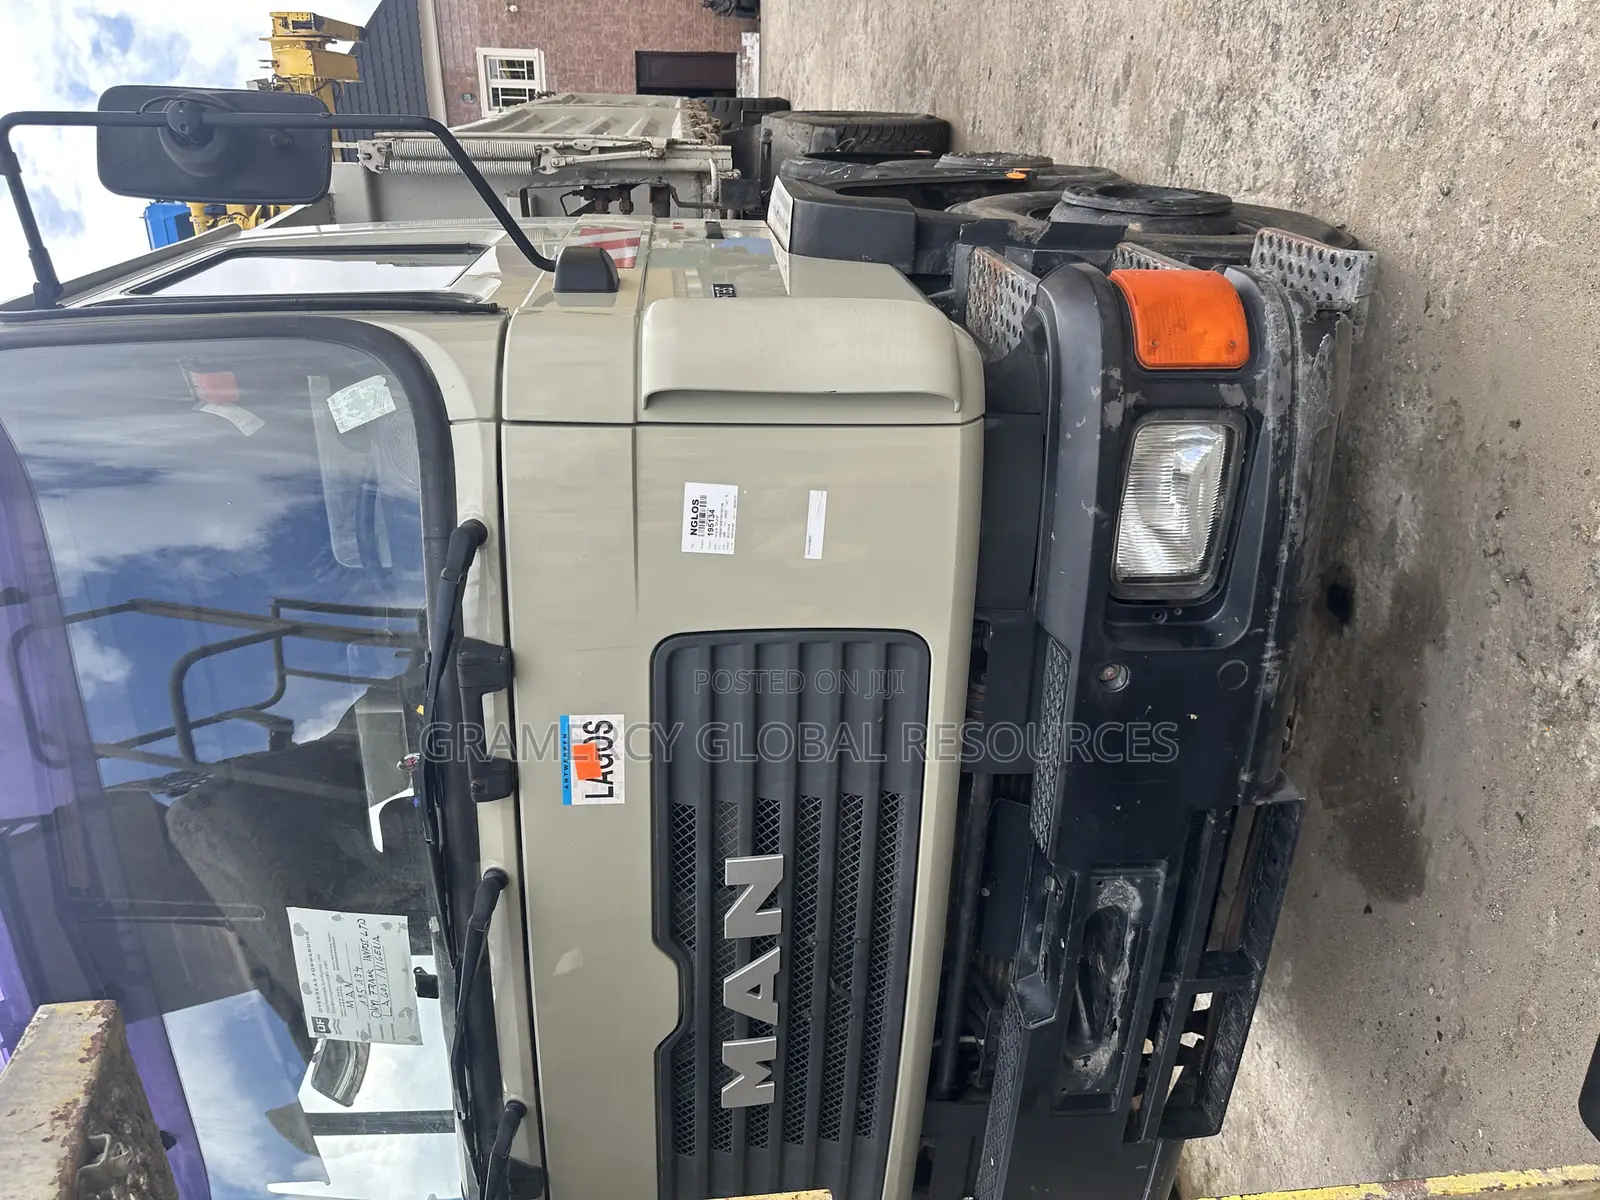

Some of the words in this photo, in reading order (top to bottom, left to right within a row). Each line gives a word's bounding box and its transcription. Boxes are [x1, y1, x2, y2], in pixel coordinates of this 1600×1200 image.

[690, 499, 699, 536] NGLOS
[707, 509, 715, 537] 195134
[562, 733, 570, 790] ANTWERPEN
[357, 918, 369, 936] LTD
[305, 931, 316, 976] FORWARDING
[313, 978, 322, 1013] OVERSEAS
[344, 981, 355, 1008] MAN
[721, 854, 784, 1109] MAN
[316, 1017, 326, 1032] OF
